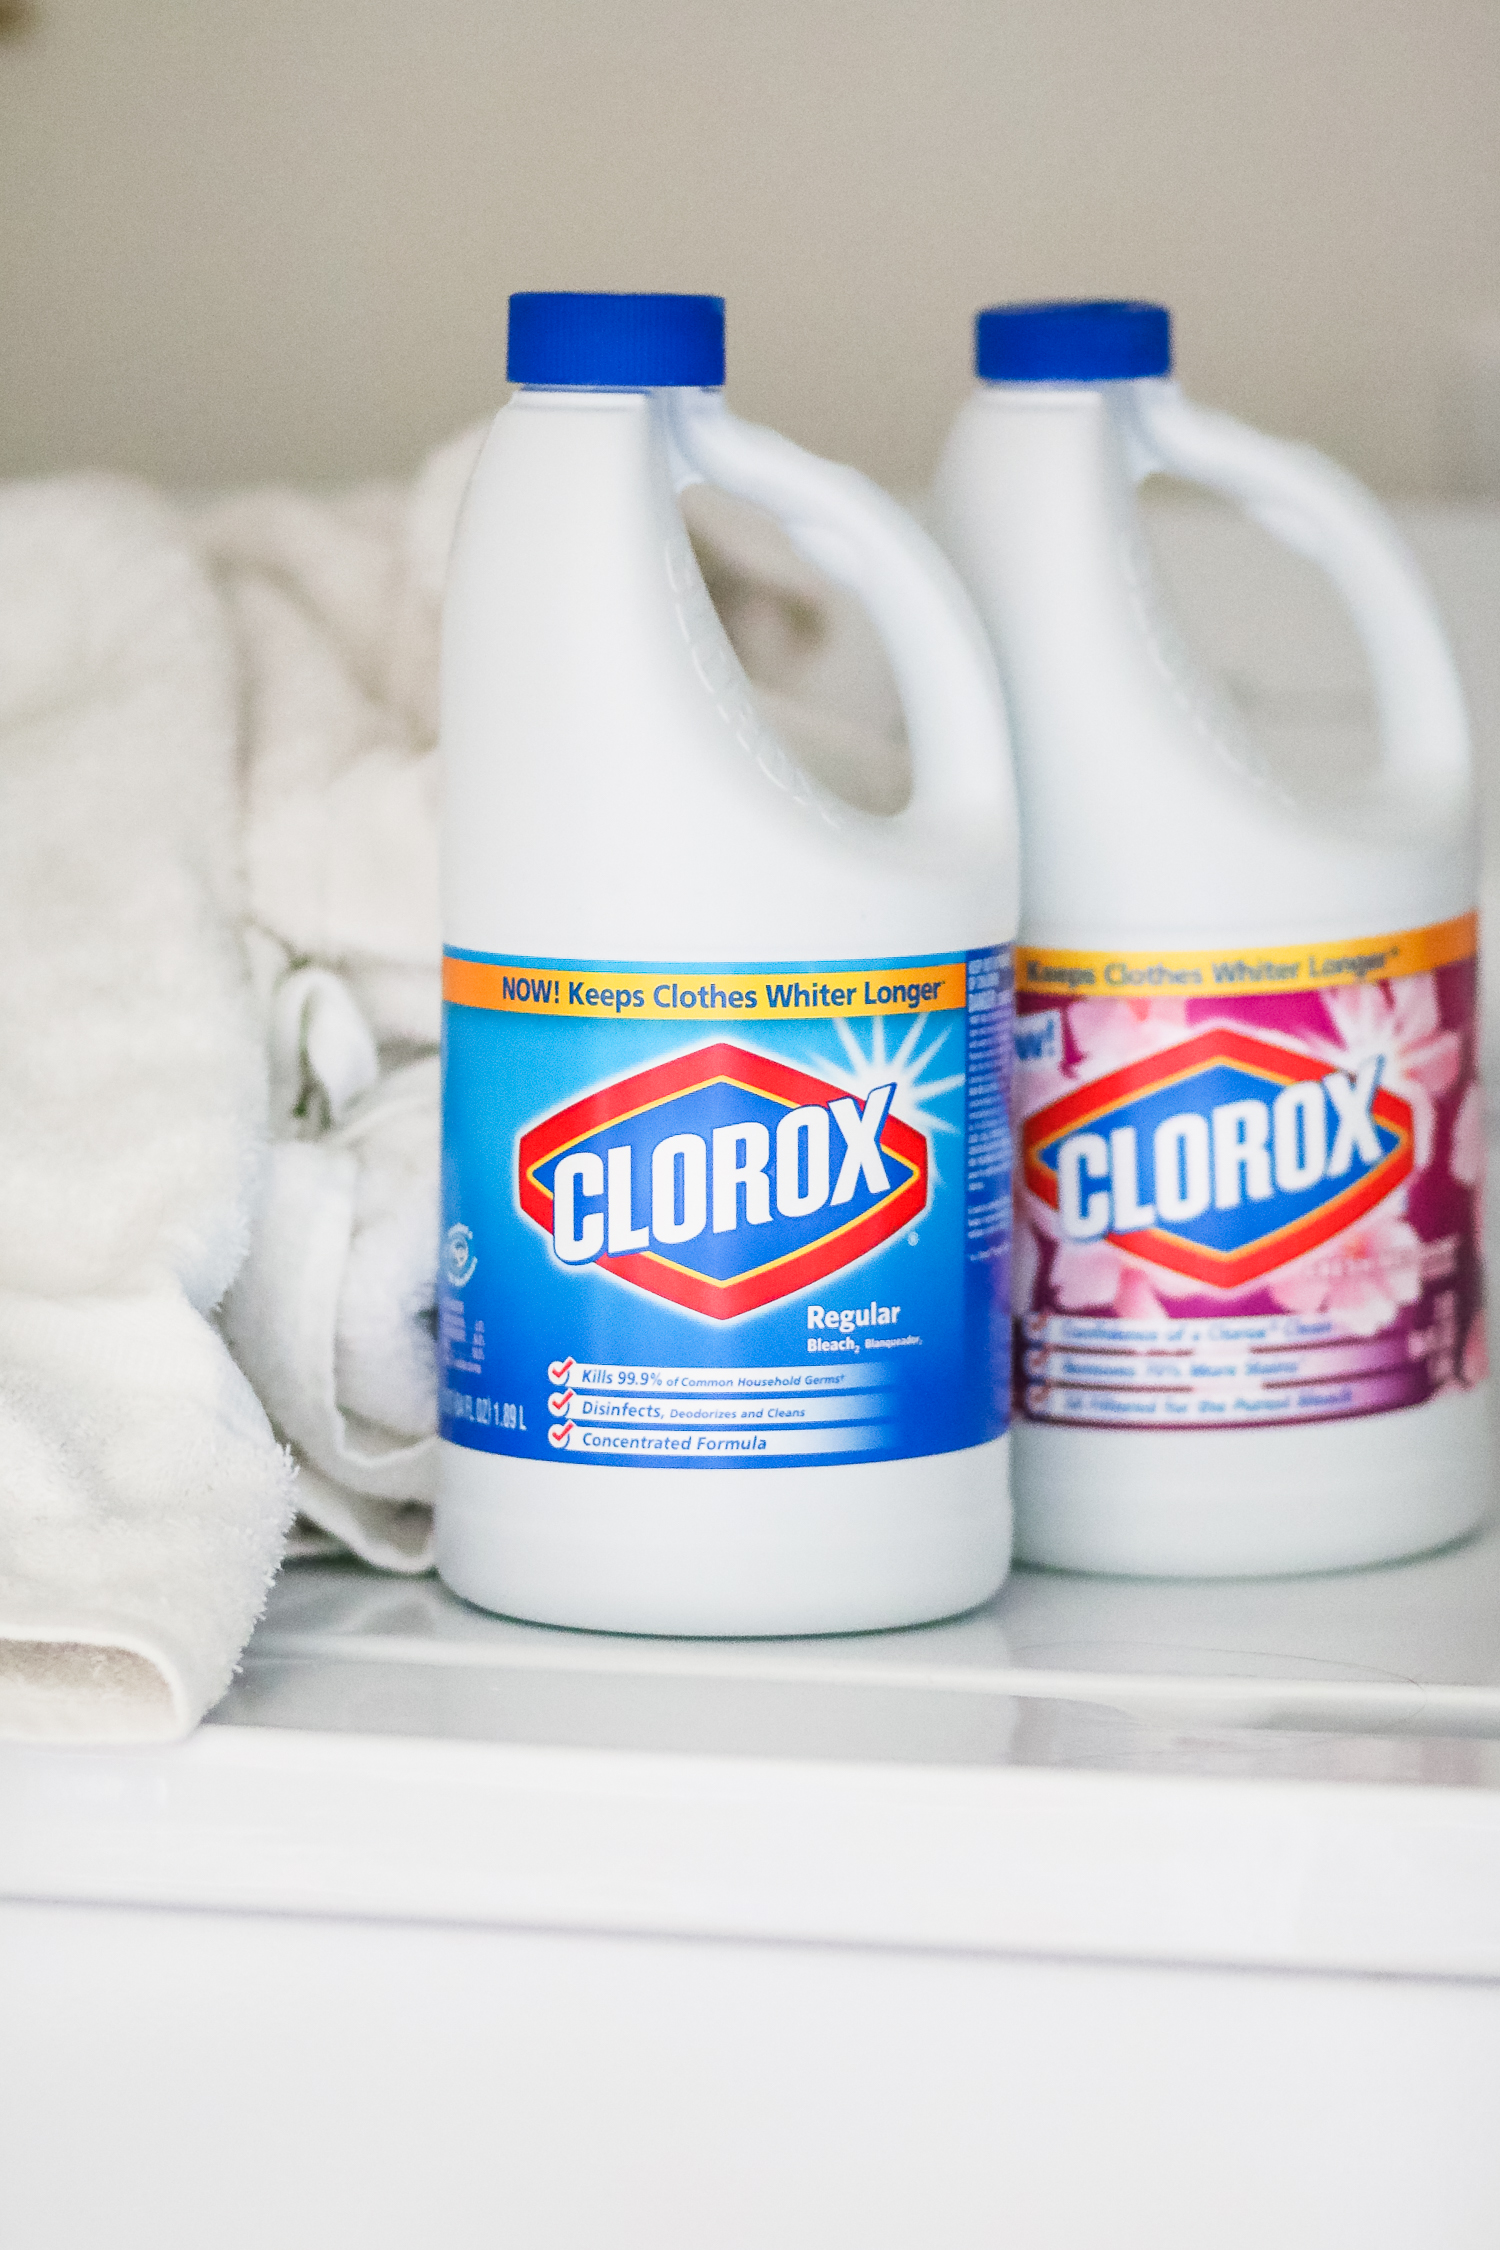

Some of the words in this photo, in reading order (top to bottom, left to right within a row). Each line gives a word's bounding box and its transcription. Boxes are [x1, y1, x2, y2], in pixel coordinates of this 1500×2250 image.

[1103, 962, 1203, 986] Clothes
[502, 975, 560, 1004] NOW!
[569, 981, 645, 1013] Keeps
[653, 983, 758, 1009] Clothes
[765, 982, 857, 1008] Whiter
[1056, 1054, 1385, 1243] CLOROX
[553, 1082, 897, 1265] CLOROX
[807, 1301, 901, 1333] Regular
[582, 1369, 613, 1385] Kills
[618, 1371, 662, 1386] 99.9%
[666, 1376, 680, 1387] of
[682, 1377, 734, 1387] Common
[737, 1375, 801, 1387] Household
[582, 1401, 665, 1419] Disinfects,
[670, 1408, 737, 1419] Deodorizes
[741, 1408, 764, 1418] and
[767, 1408, 806, 1418] Cleans
[582, 1432, 692, 1450] Concentrated
[697, 1435, 767, 1450] Formula
